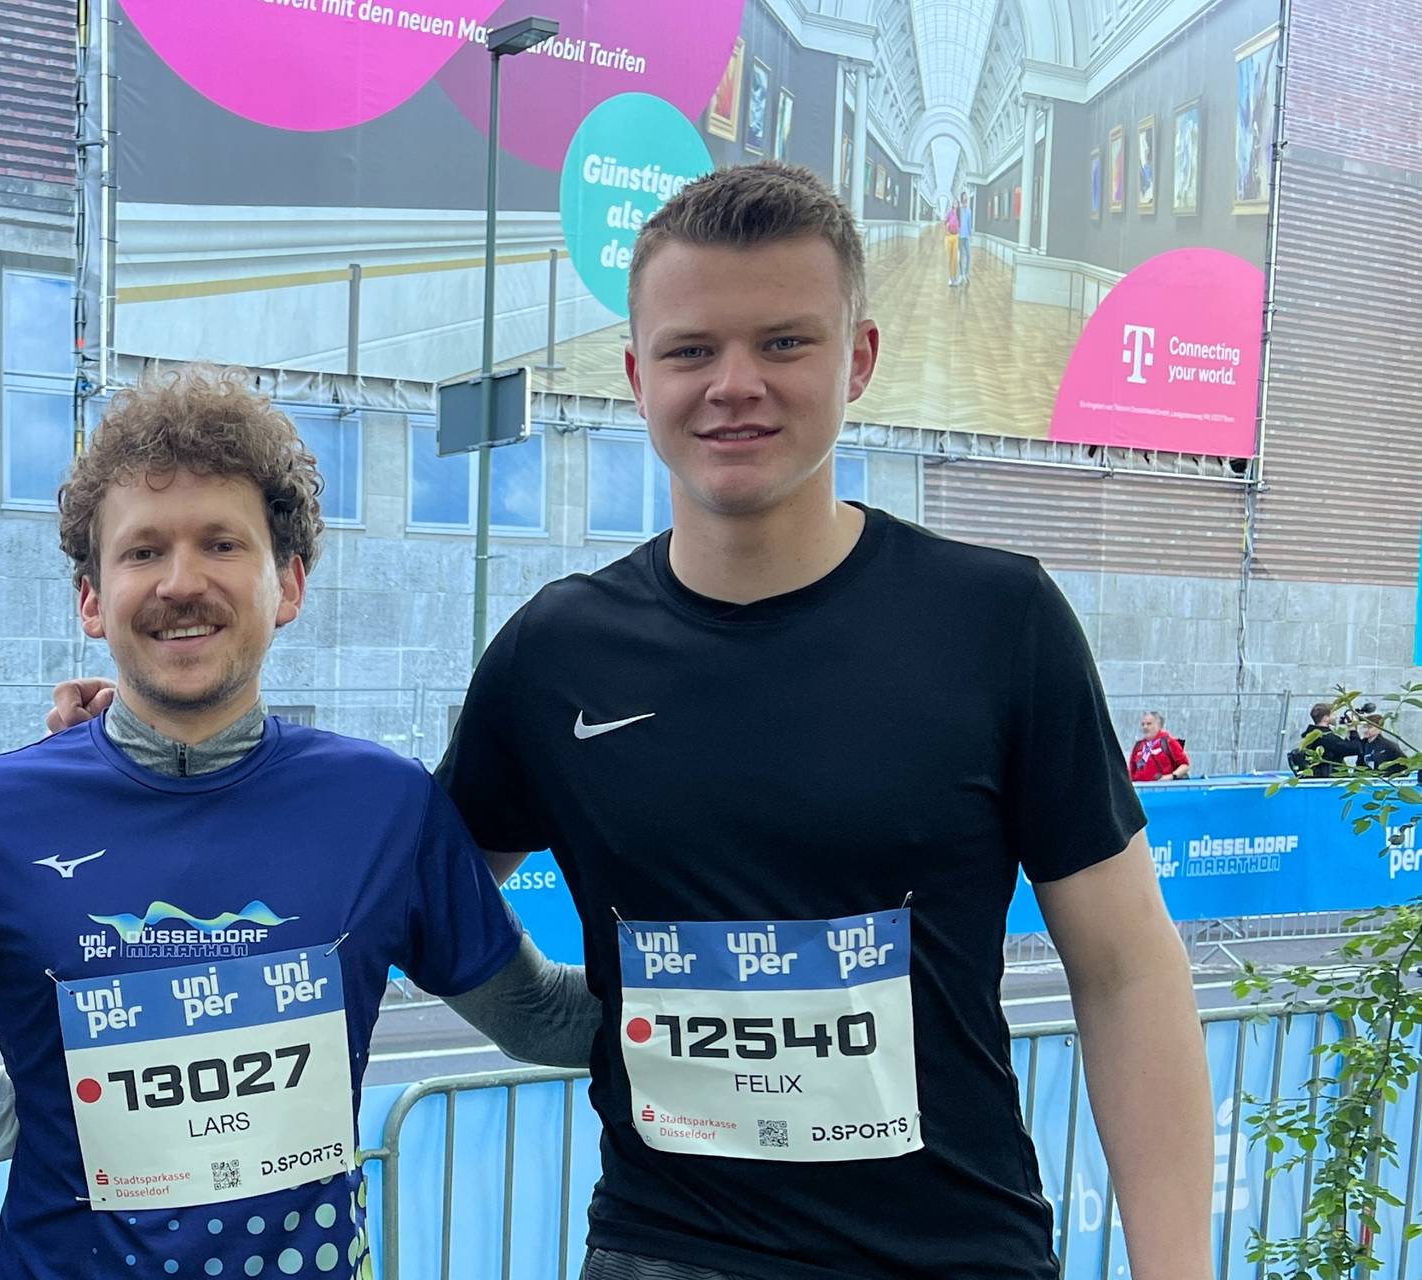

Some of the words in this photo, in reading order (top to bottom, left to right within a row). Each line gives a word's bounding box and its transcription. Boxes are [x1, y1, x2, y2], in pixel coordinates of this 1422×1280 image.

[322, 0, 354, 18] mit
[358, 0, 393, 26] den
[398, 10, 454, 38] neuen
[589, 42, 647, 74] Tarifen
[607, 200, 643, 231] als
[1169, 336, 1240, 366] Connecting
[1168, 364, 1196, 383] your
[1199, 366, 1236, 385] world.
[1188, 835, 1298, 857] DÜSSELDORF
[1186, 854, 1280, 876] MARATHON
[79, 930, 106, 947] uni
[128, 927, 268, 944] DÜSSELDORF
[635, 924, 679, 952] uni
[726, 924, 776, 953] uni
[827, 916, 875, 952] uni
[84, 945, 116, 962] per
[126, 943, 248, 958] MARATHON
[838, 943, 894, 980] per
[263, 952, 310, 987] uni
[645, 951, 697, 980] per
[738, 952, 797, 982] per
[76, 979, 123, 1012] uni
[171, 967, 219, 1000] uni
[273, 977, 327, 1013] per
[87, 1005, 142, 1039] per
[184, 992, 238, 1026] per
[654, 1011, 877, 1060] 12540
[107, 1043, 311, 1112] 13027
[734, 1073, 803, 1094] FELIX
[188, 1111, 251, 1138] LARS
[659, 1113, 737, 1130] Stadtsparkasse
[659, 1127, 716, 1141] Düsseldorf
[812, 1117, 908, 1142] D.SPORTS
[260, 1142, 343, 1176] D.SPORTS
[113, 1170, 191, 1186] Stadtsparkasse
[115, 1185, 170, 1198] Düsseldorf
